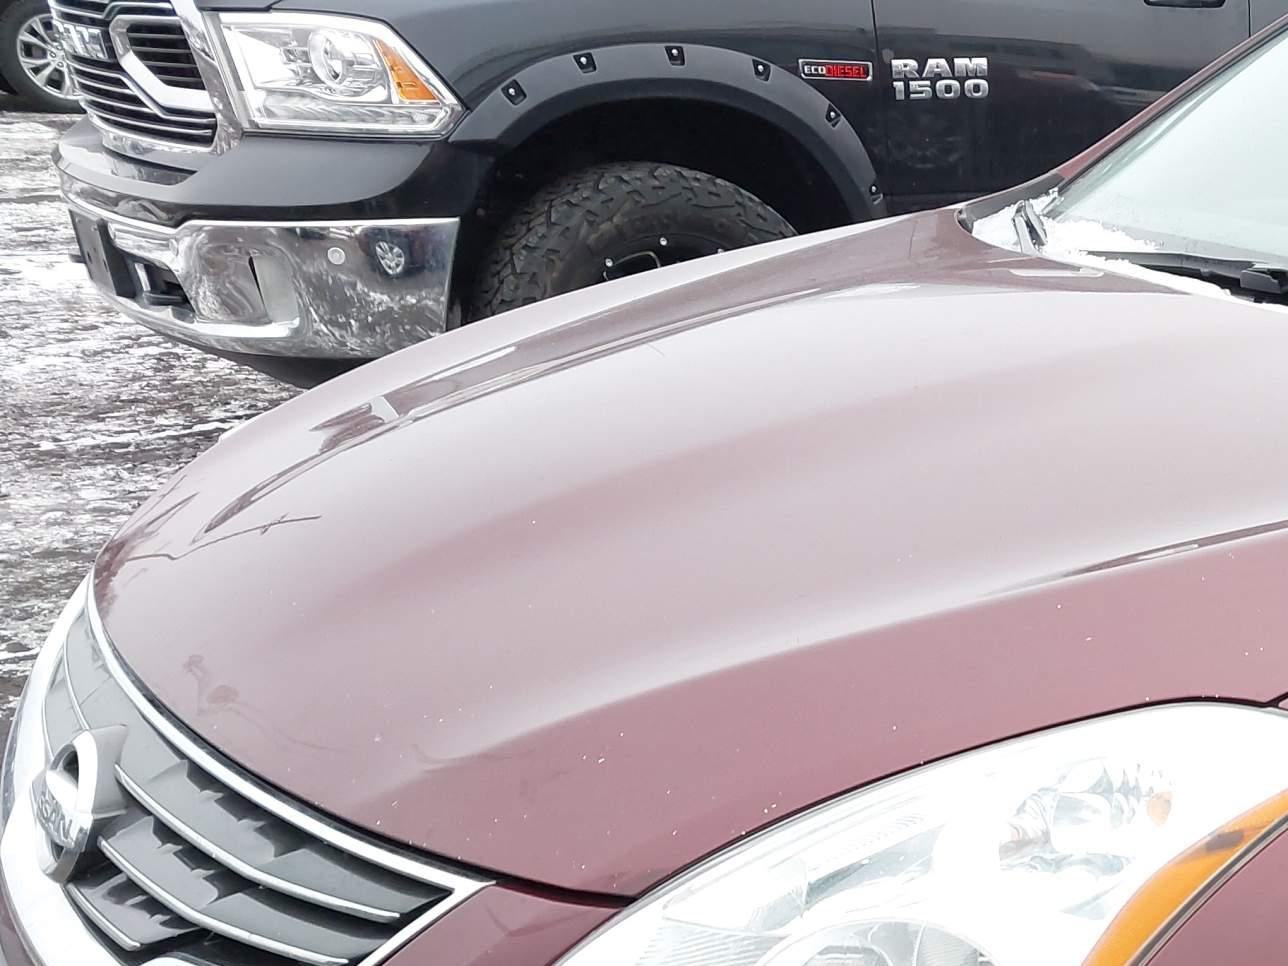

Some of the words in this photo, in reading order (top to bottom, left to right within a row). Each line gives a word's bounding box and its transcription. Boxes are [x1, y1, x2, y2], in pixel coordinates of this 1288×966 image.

[803, 64, 866, 78] ECODIESEL
[891, 57, 988, 79] RAM
[892, 78, 989, 101] 1500
